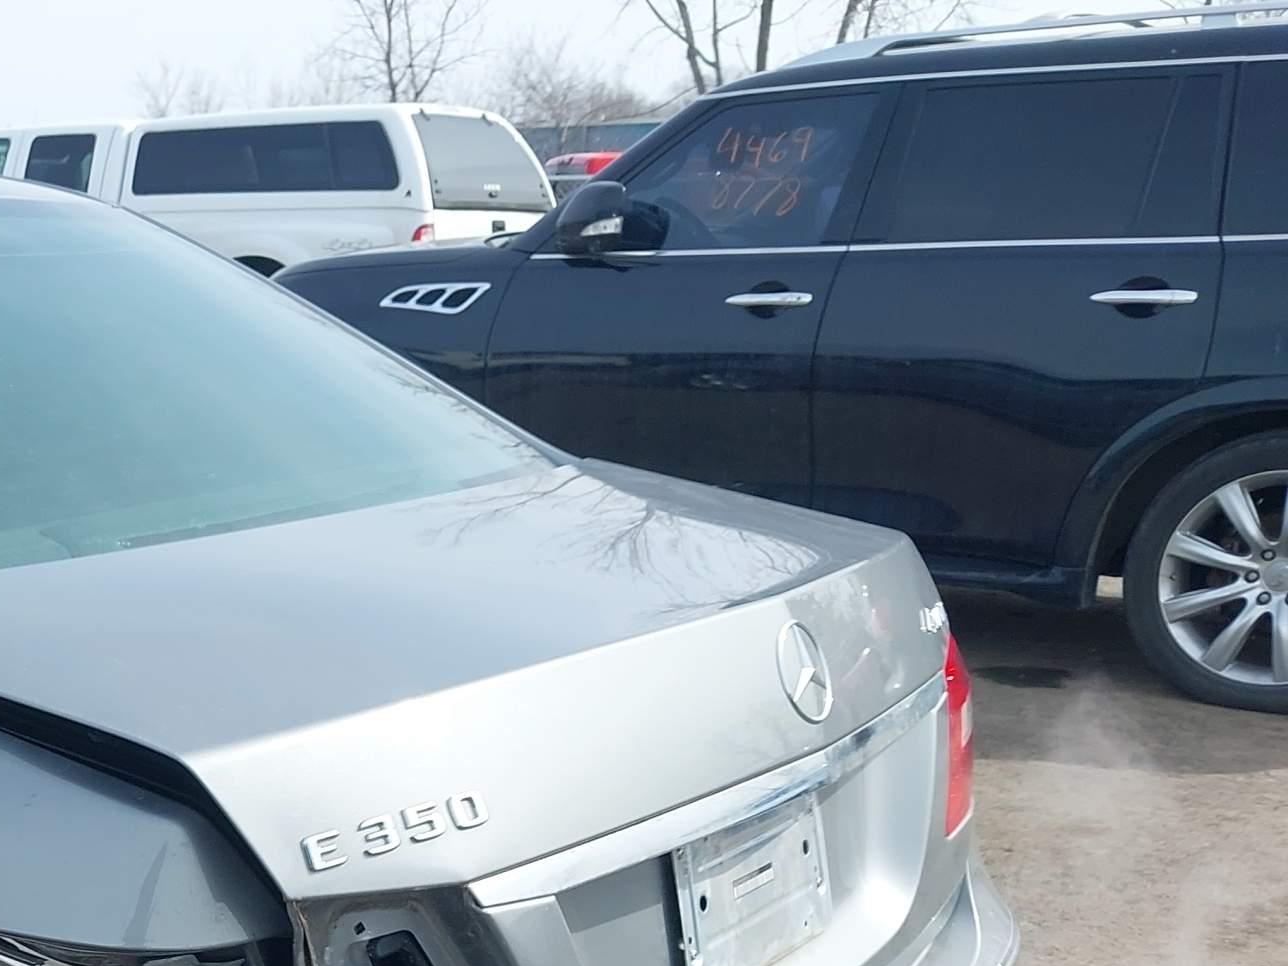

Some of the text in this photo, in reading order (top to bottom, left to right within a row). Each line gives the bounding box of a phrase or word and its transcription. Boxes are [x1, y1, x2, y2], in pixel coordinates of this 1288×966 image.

[716, 127, 813, 168] 4469
[712, 176, 801, 216] 8778
[300, 791, 489, 873] E 350
